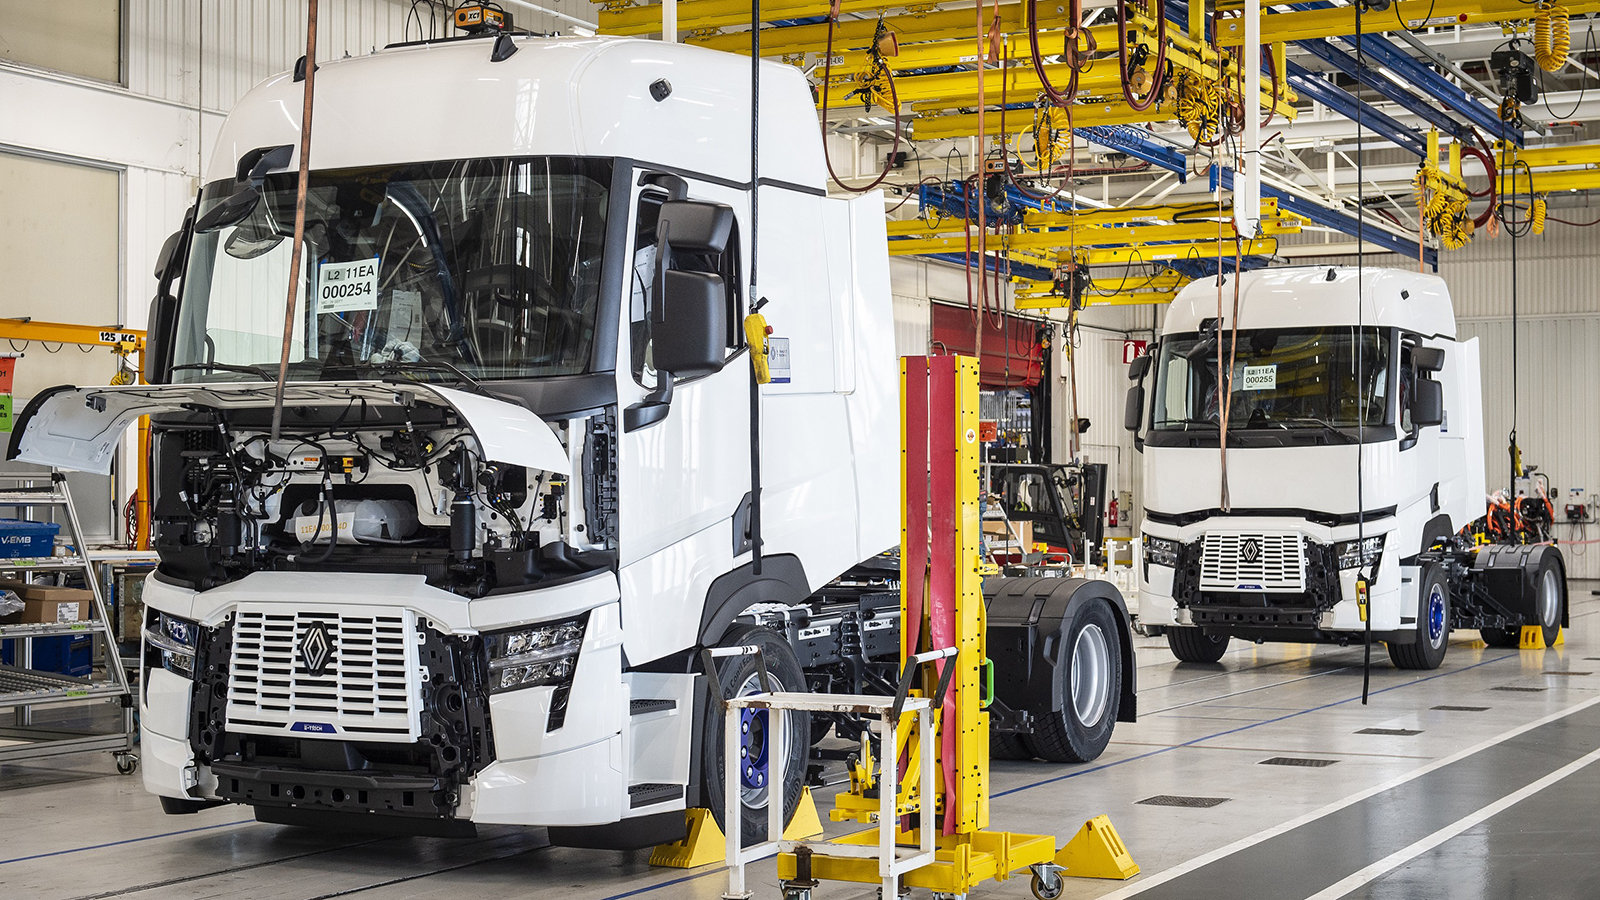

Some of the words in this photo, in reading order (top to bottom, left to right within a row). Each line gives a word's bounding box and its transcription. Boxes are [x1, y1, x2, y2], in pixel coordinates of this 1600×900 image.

[327, 270, 340, 281] L2
[346, 265, 375, 279] 11EA
[322, 281, 372, 299] 000254
[100, 332, 116, 342] 125
[121, 334, 135, 343] KG
[1245, 376, 1273, 384] 000255
